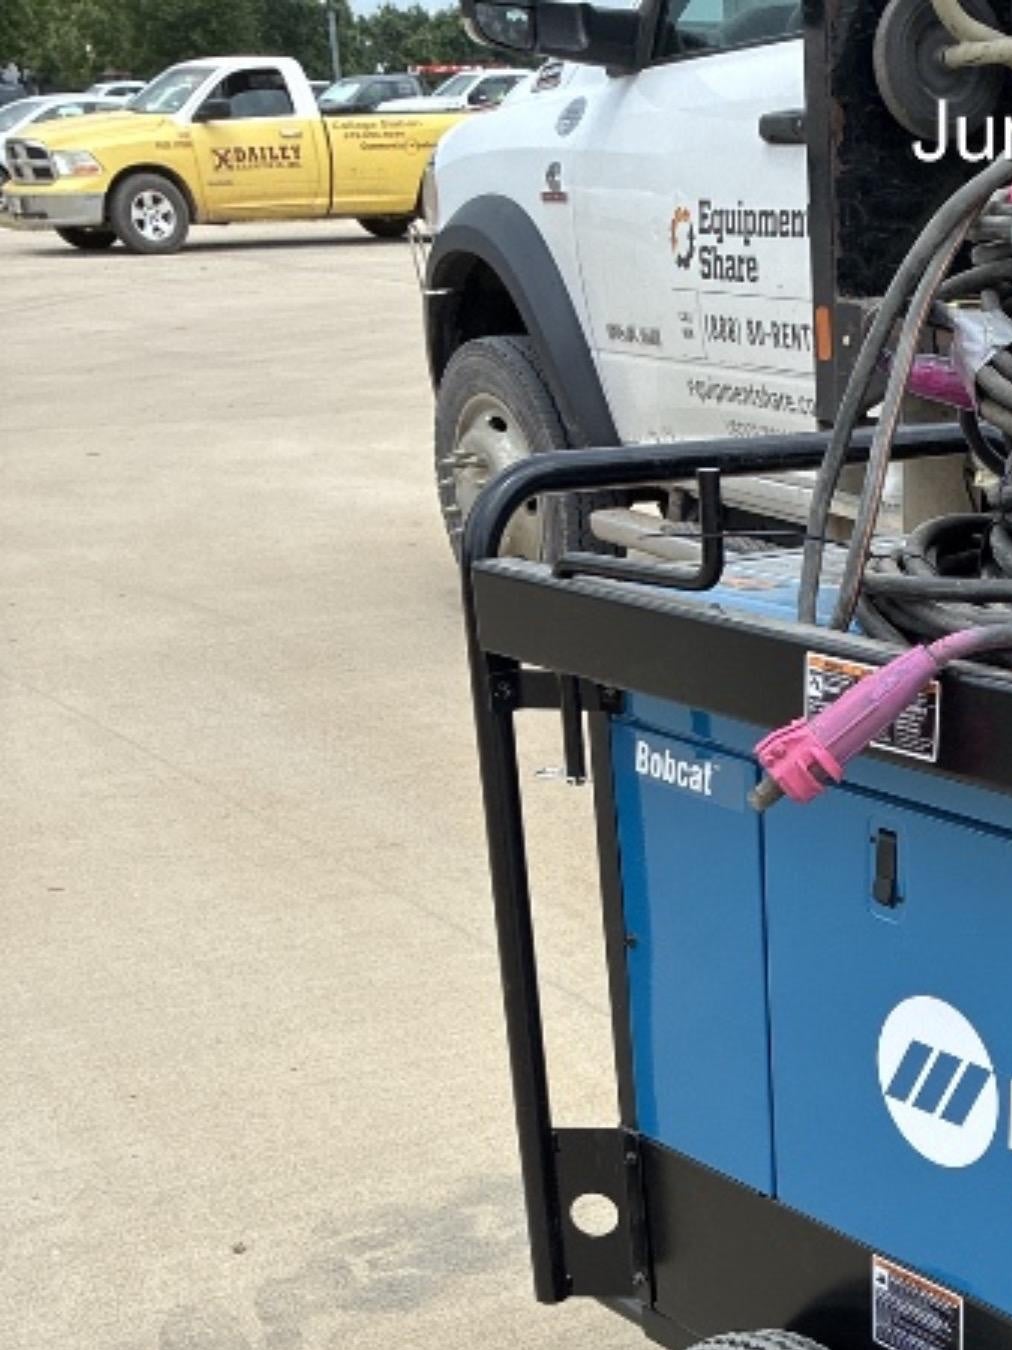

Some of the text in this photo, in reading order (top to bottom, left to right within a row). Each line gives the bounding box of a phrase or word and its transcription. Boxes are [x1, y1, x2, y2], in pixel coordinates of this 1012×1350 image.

[698, 200, 809, 246] Equipmen
[699, 245, 759, 283] Share
[634, 740, 713, 797] Bobcat
